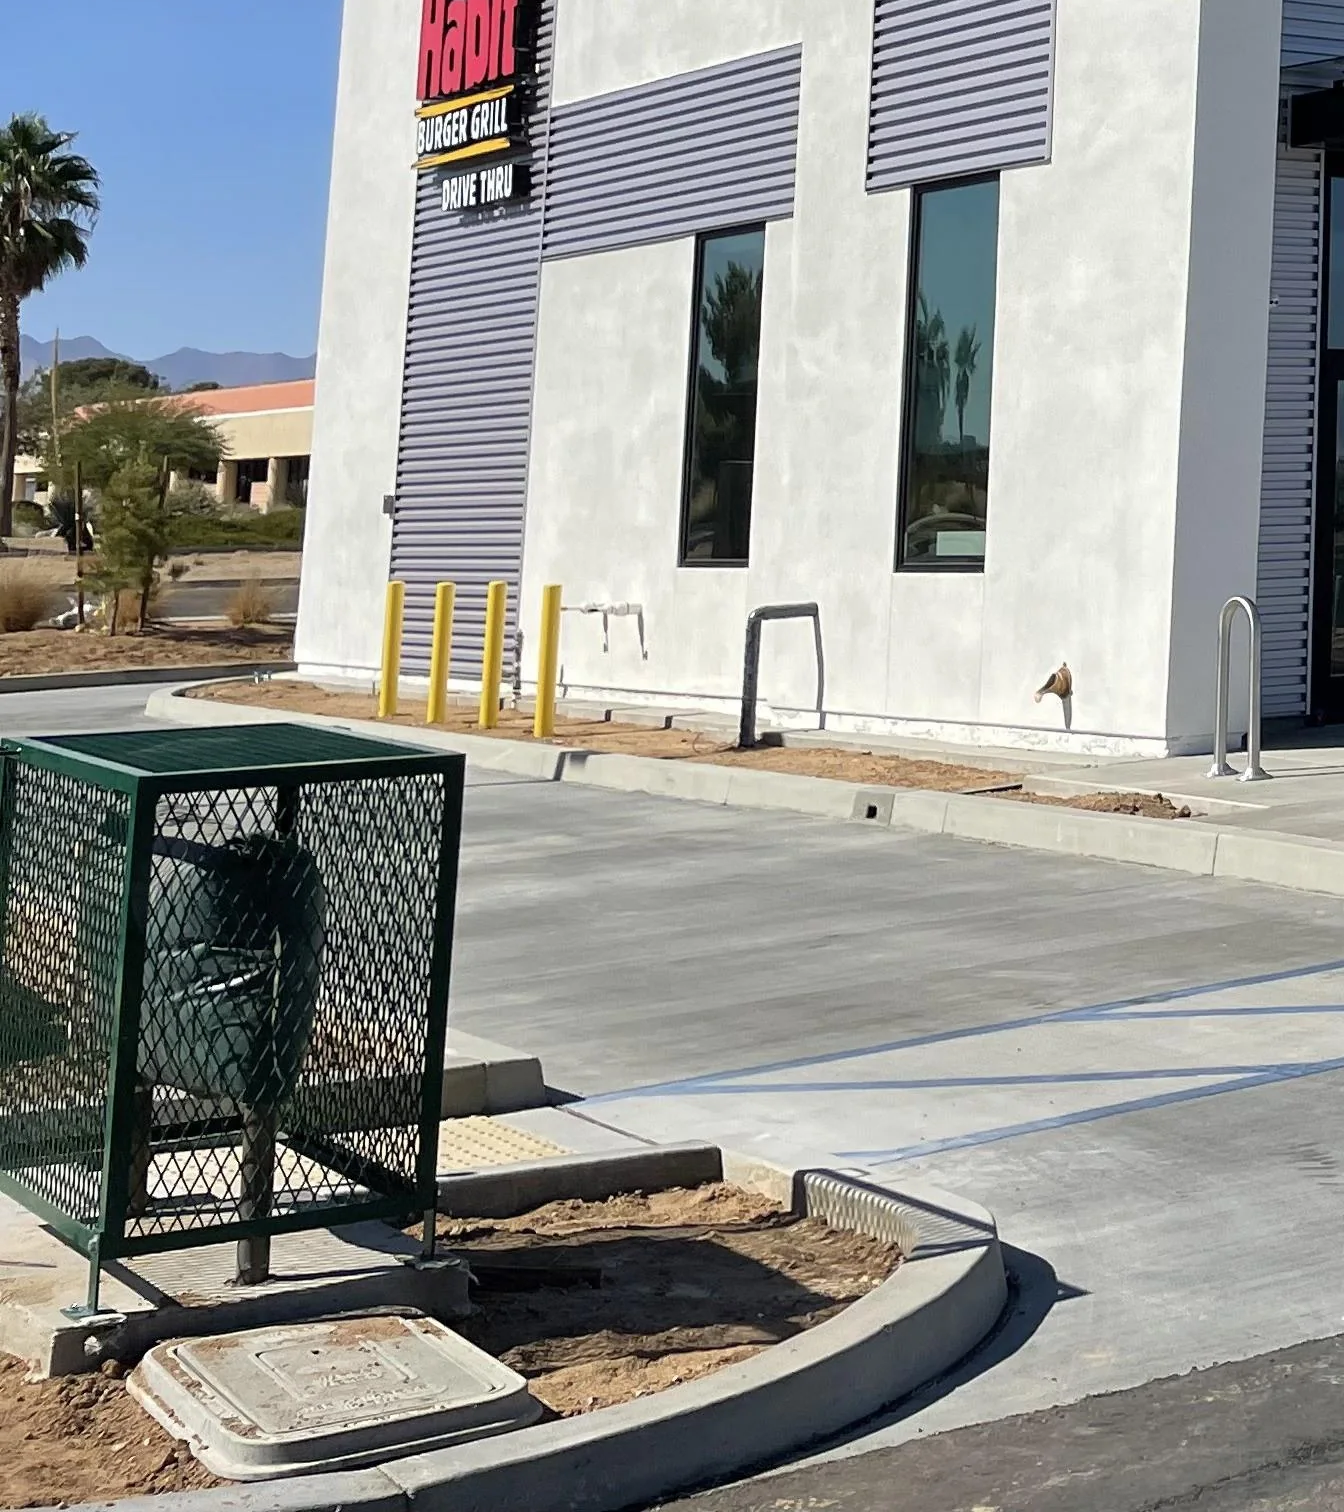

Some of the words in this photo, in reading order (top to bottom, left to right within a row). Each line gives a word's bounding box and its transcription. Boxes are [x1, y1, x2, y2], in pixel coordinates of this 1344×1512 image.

[417, 108, 468, 154] BURGER
[470, 97, 508, 140] GRILL
[441, 173, 477, 212] DRIVE
[480, 163, 513, 204] THRU
